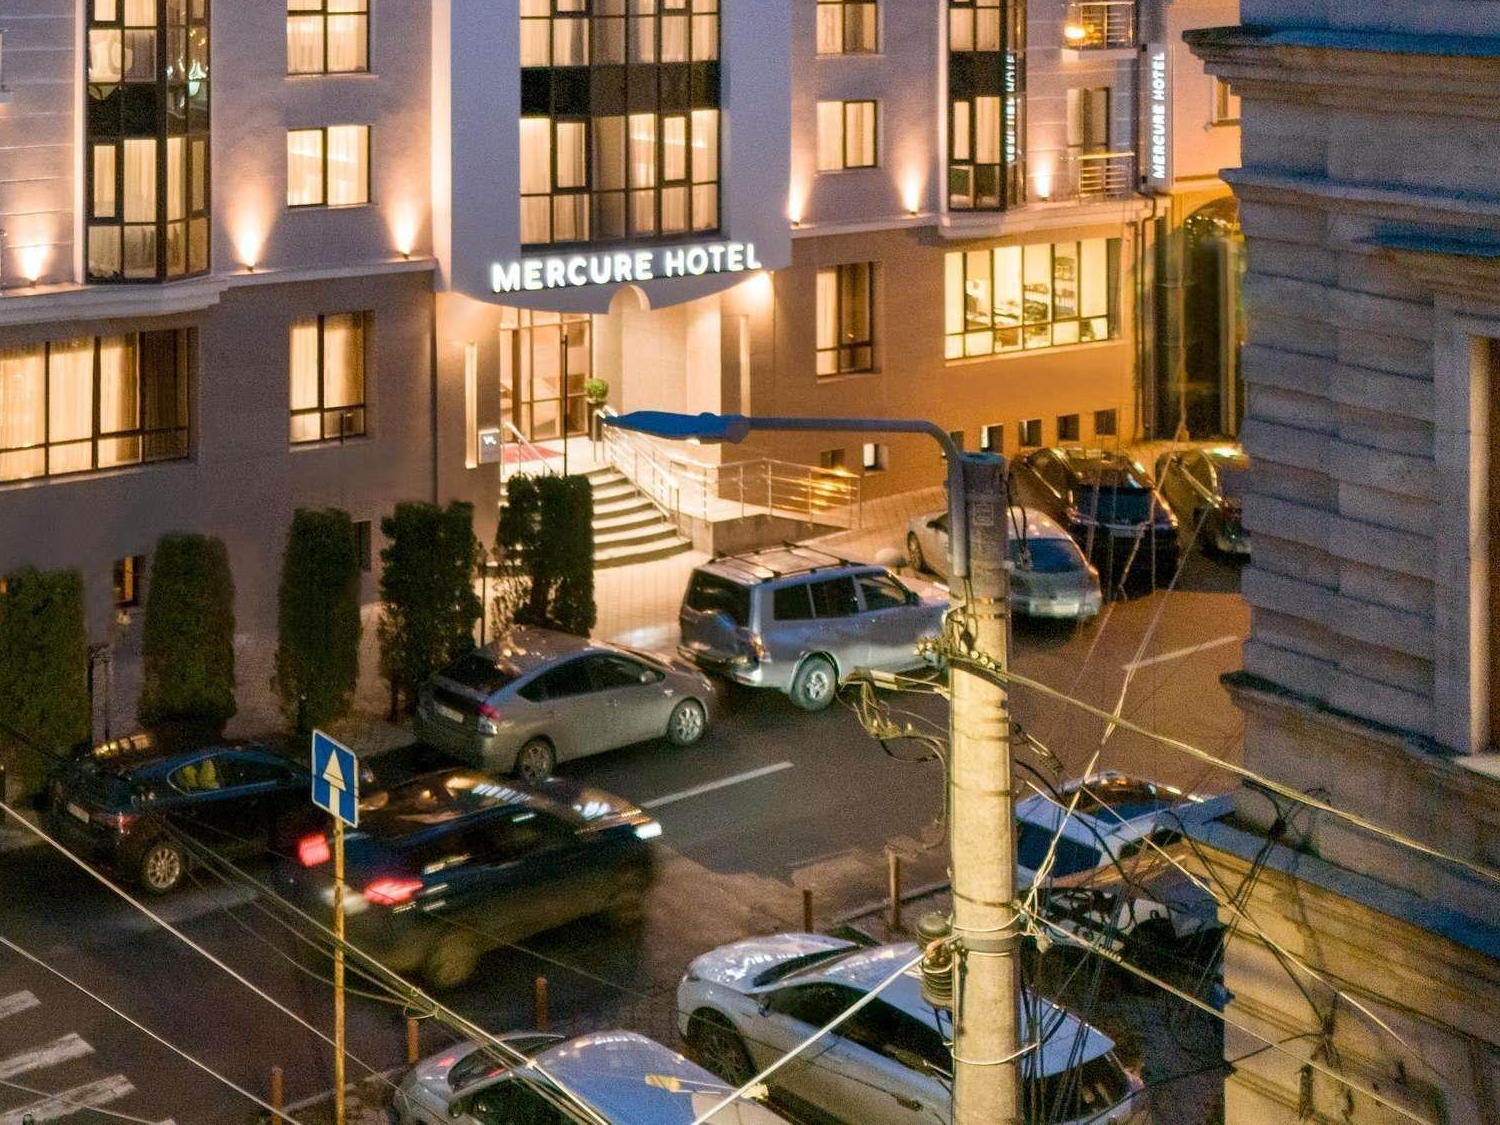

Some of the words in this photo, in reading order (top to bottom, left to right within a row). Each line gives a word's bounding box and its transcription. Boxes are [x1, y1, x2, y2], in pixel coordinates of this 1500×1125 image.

[1151, 52, 1166, 101] HOTEL
[1151, 103, 1166, 179] MERCURE
[490, 251, 654, 293] MERCURE
[664, 242, 764, 278] HOTEL
